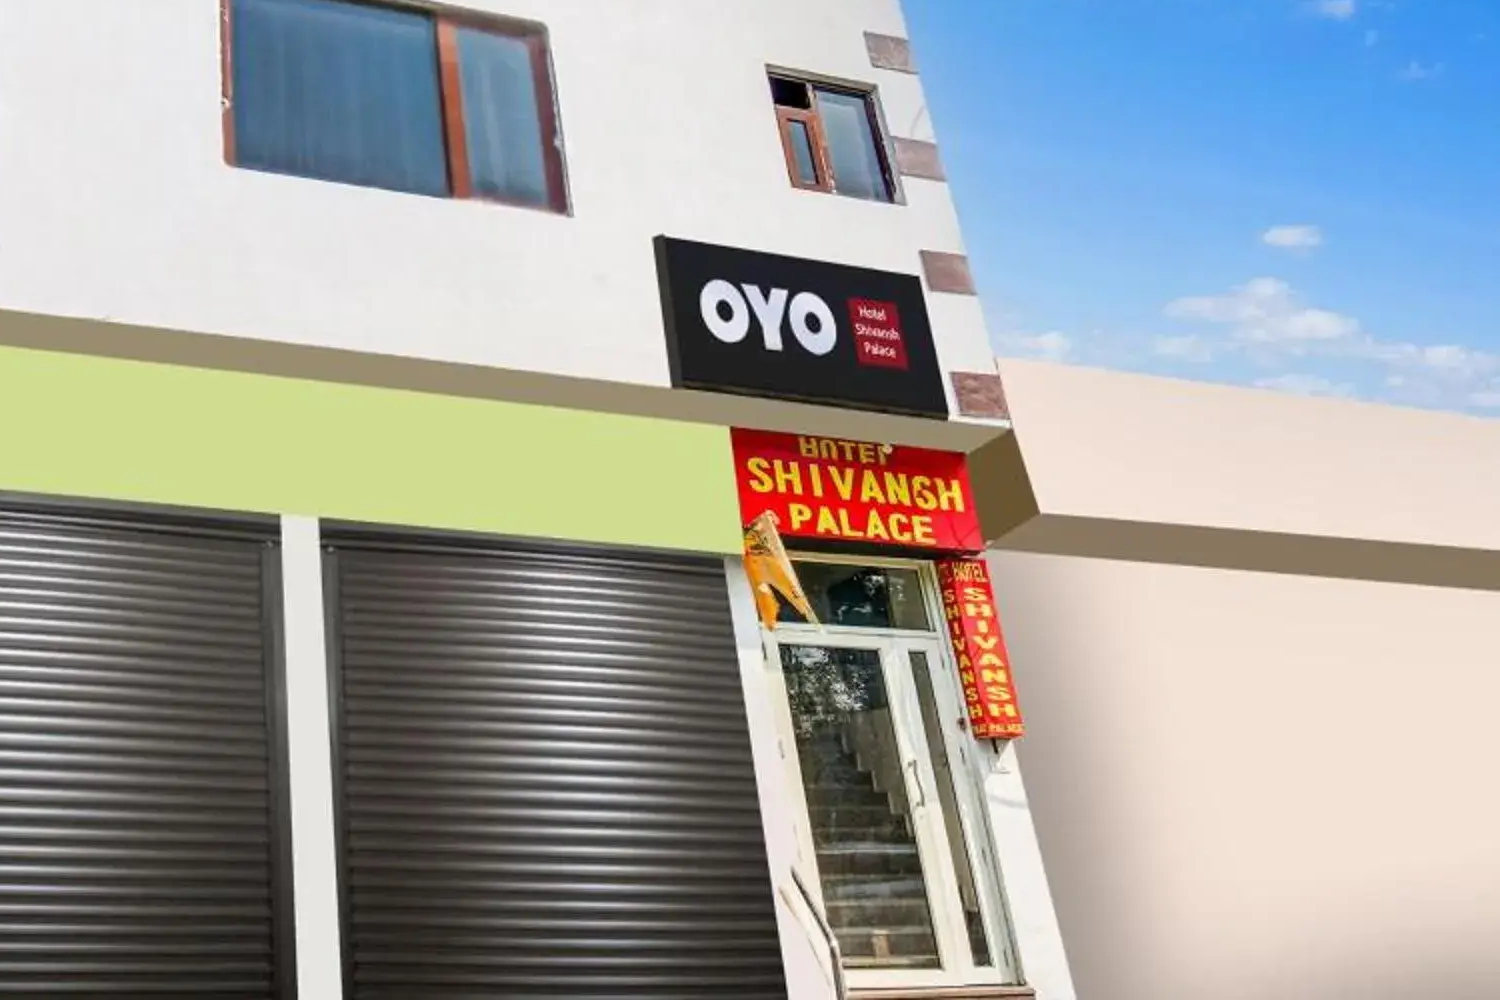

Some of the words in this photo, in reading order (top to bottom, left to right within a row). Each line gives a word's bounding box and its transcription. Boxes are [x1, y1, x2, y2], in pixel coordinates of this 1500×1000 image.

[700, 279, 837, 356] OYO
[857, 305, 887, 321] Hotel
[863, 341, 897, 359] Palace
[747, 457, 965, 513] SHIVANSH
[789, 503, 937, 545] PALACE
[963, 587, 1018, 717] SHIVANSH
